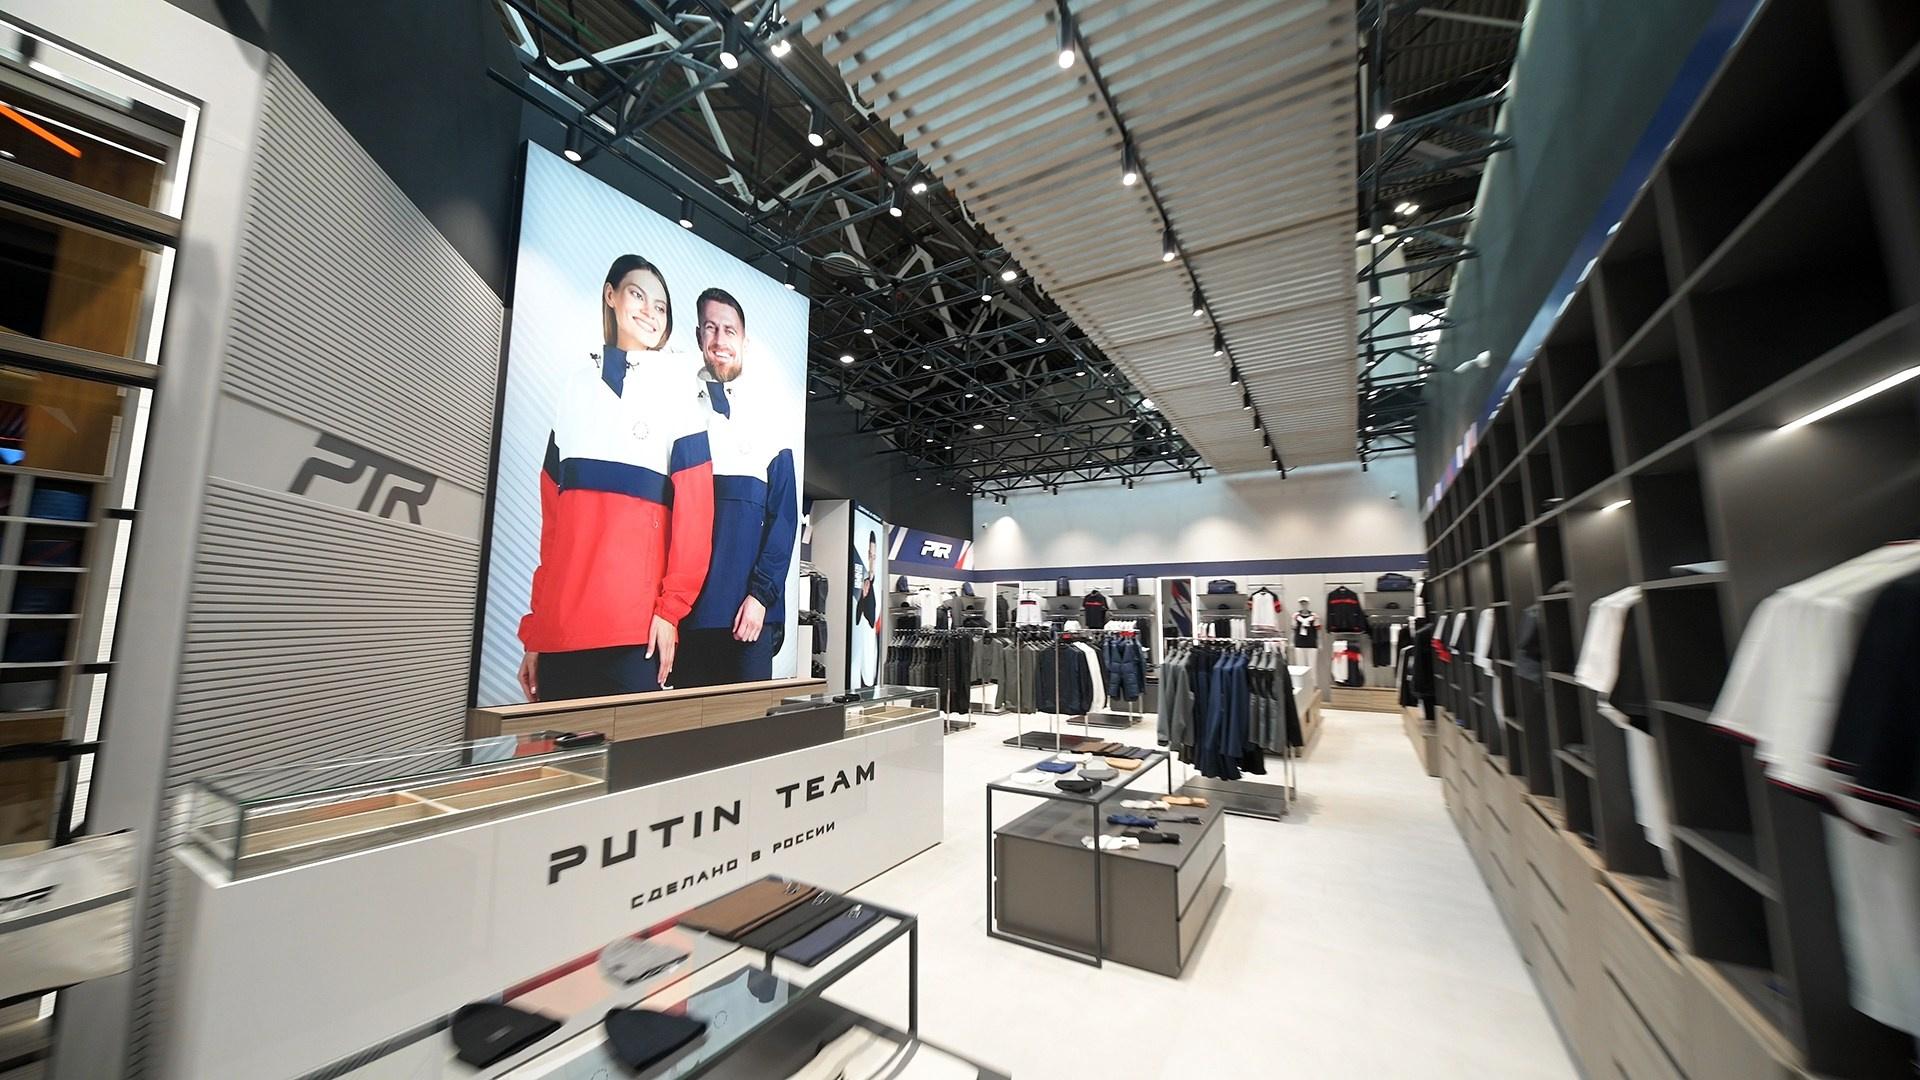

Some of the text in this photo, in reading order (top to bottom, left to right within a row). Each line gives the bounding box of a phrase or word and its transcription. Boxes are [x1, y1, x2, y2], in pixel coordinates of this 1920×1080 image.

[548, 760, 875, 886] PUTIN TEAM
[631, 821, 836, 910] СДЕЛАНО В РОССИИ
